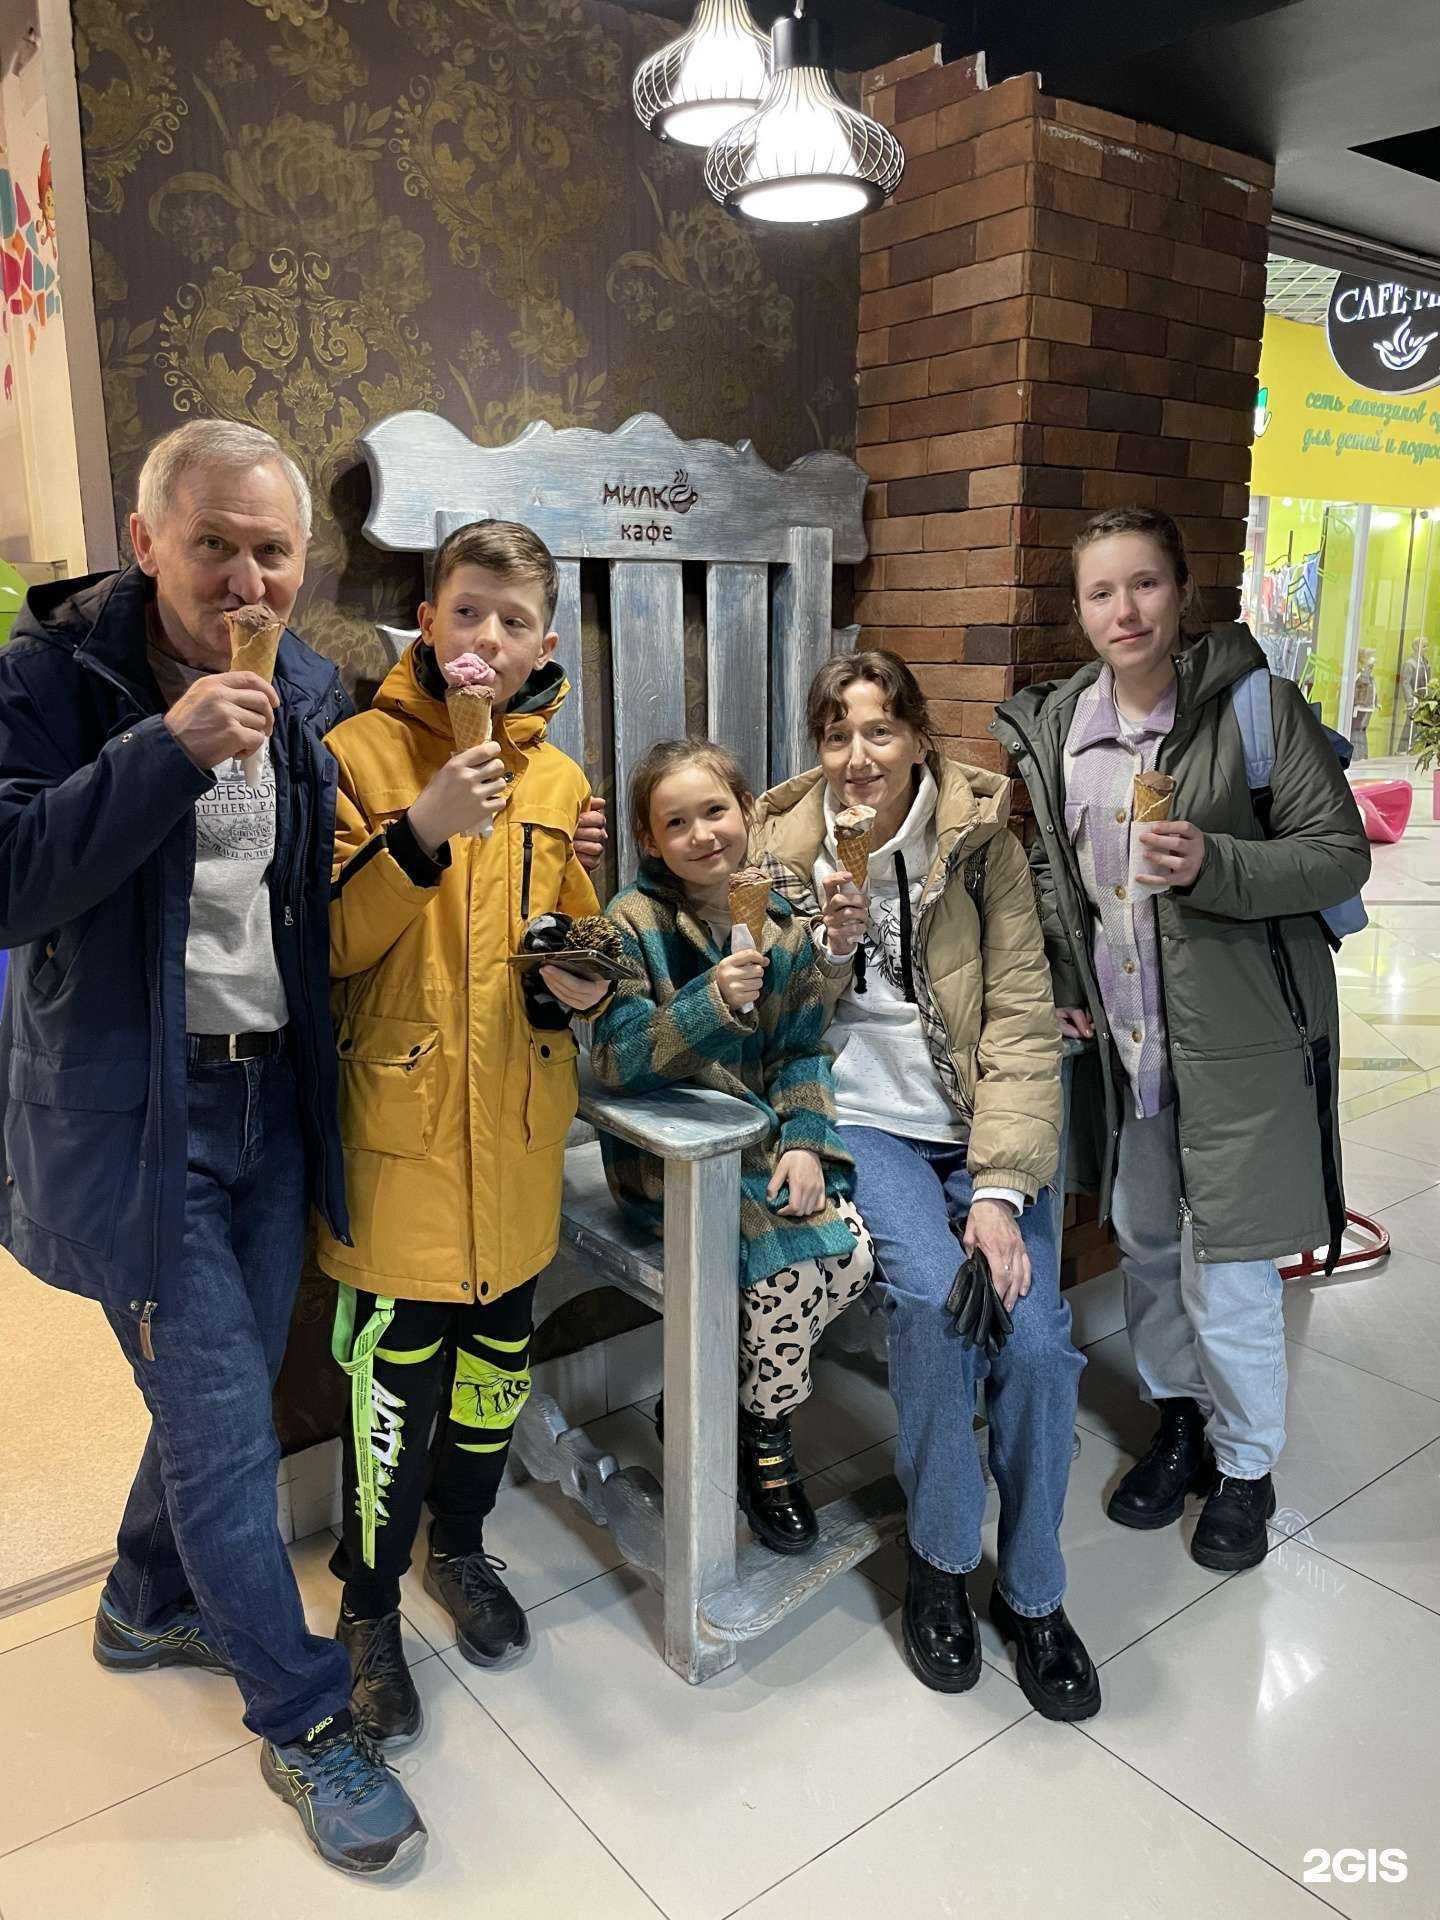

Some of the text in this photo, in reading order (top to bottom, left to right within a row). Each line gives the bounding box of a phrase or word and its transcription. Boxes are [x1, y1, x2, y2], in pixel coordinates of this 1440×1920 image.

[1305, 391, 1346, 412] сеть
[1347, 399, 1428, 427] магазинов
[1301, 428, 1335, 453] для
[1335, 429, 1384, 456] детей
[1385, 438, 1397, 454] и
[621, 519, 673, 546] кафе
